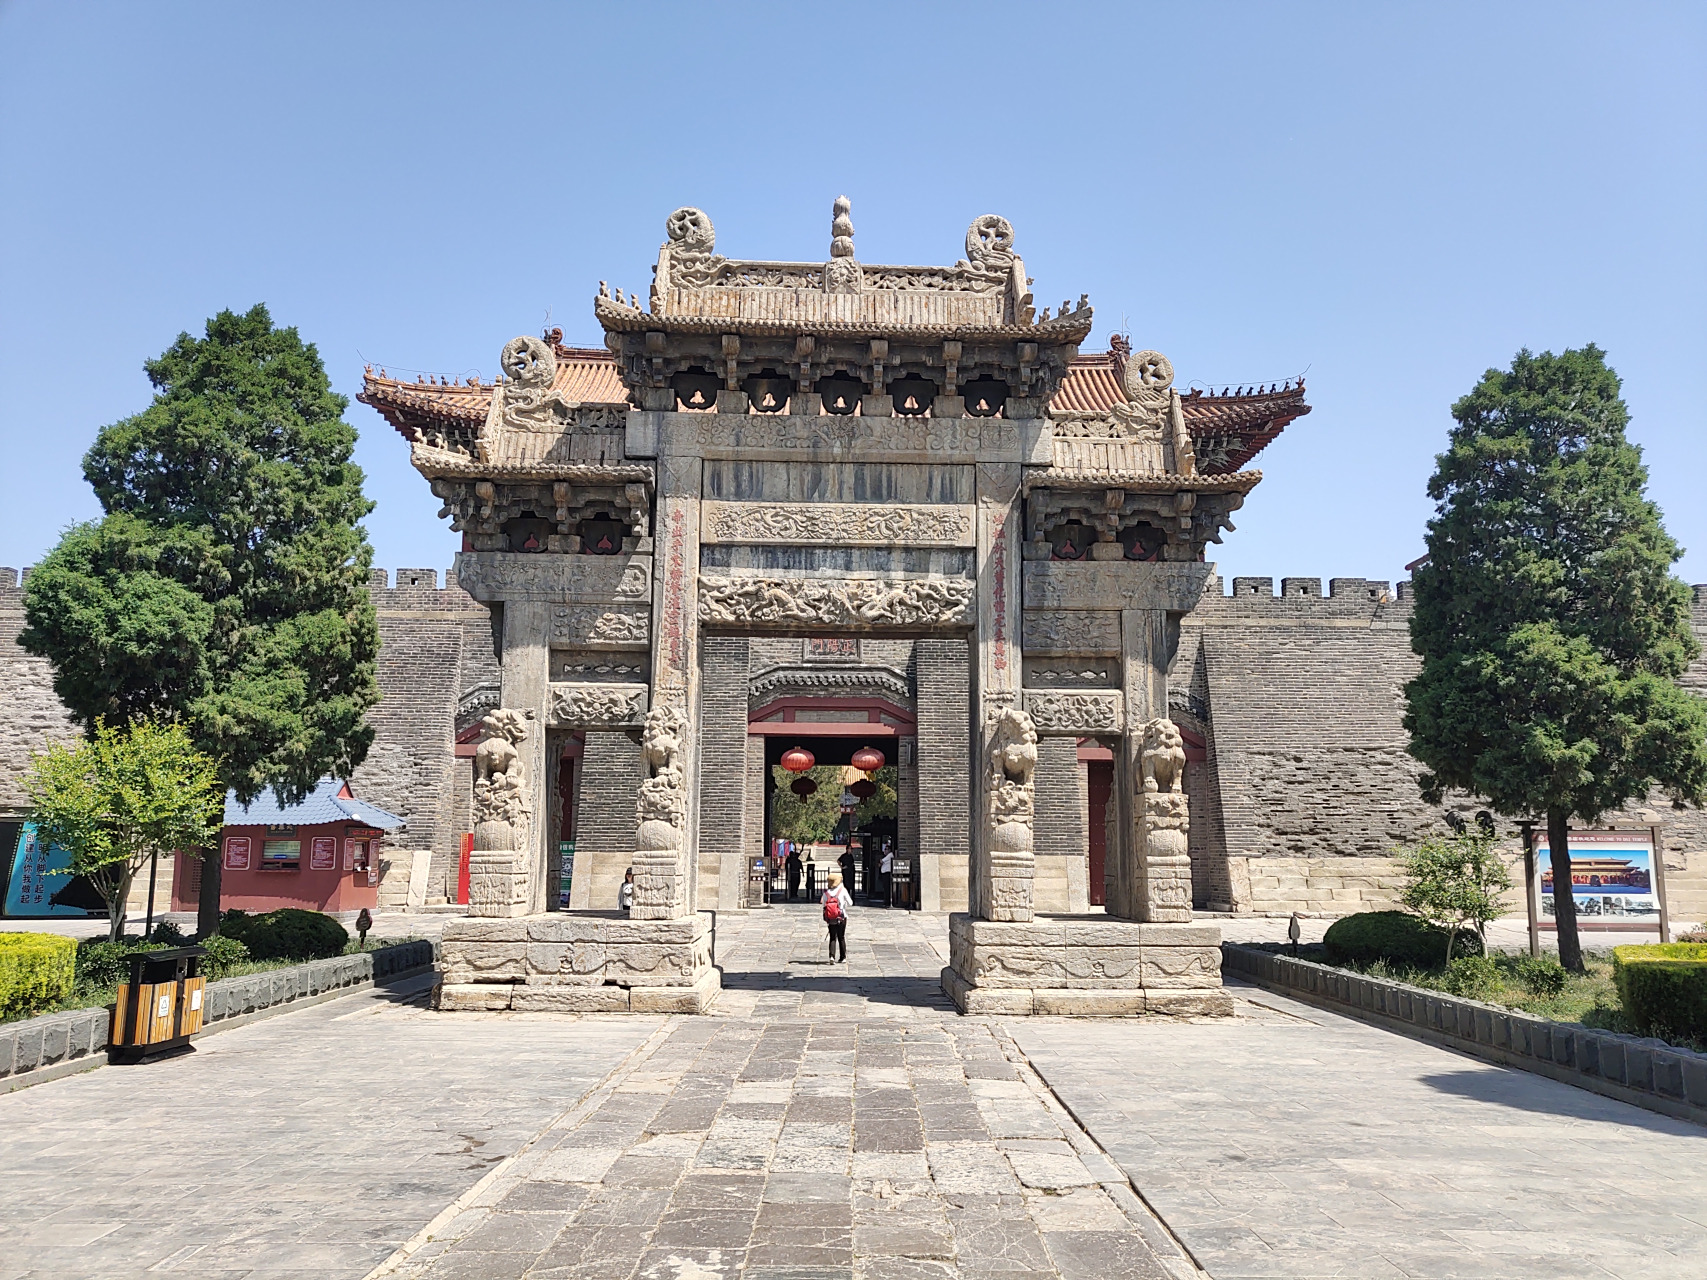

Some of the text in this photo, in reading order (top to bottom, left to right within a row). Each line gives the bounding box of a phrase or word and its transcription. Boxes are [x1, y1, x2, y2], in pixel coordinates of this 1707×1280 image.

[20, 833, 36, 904] 创建从你我做起
[33, 843, 48, 904] 明从脚下起步
